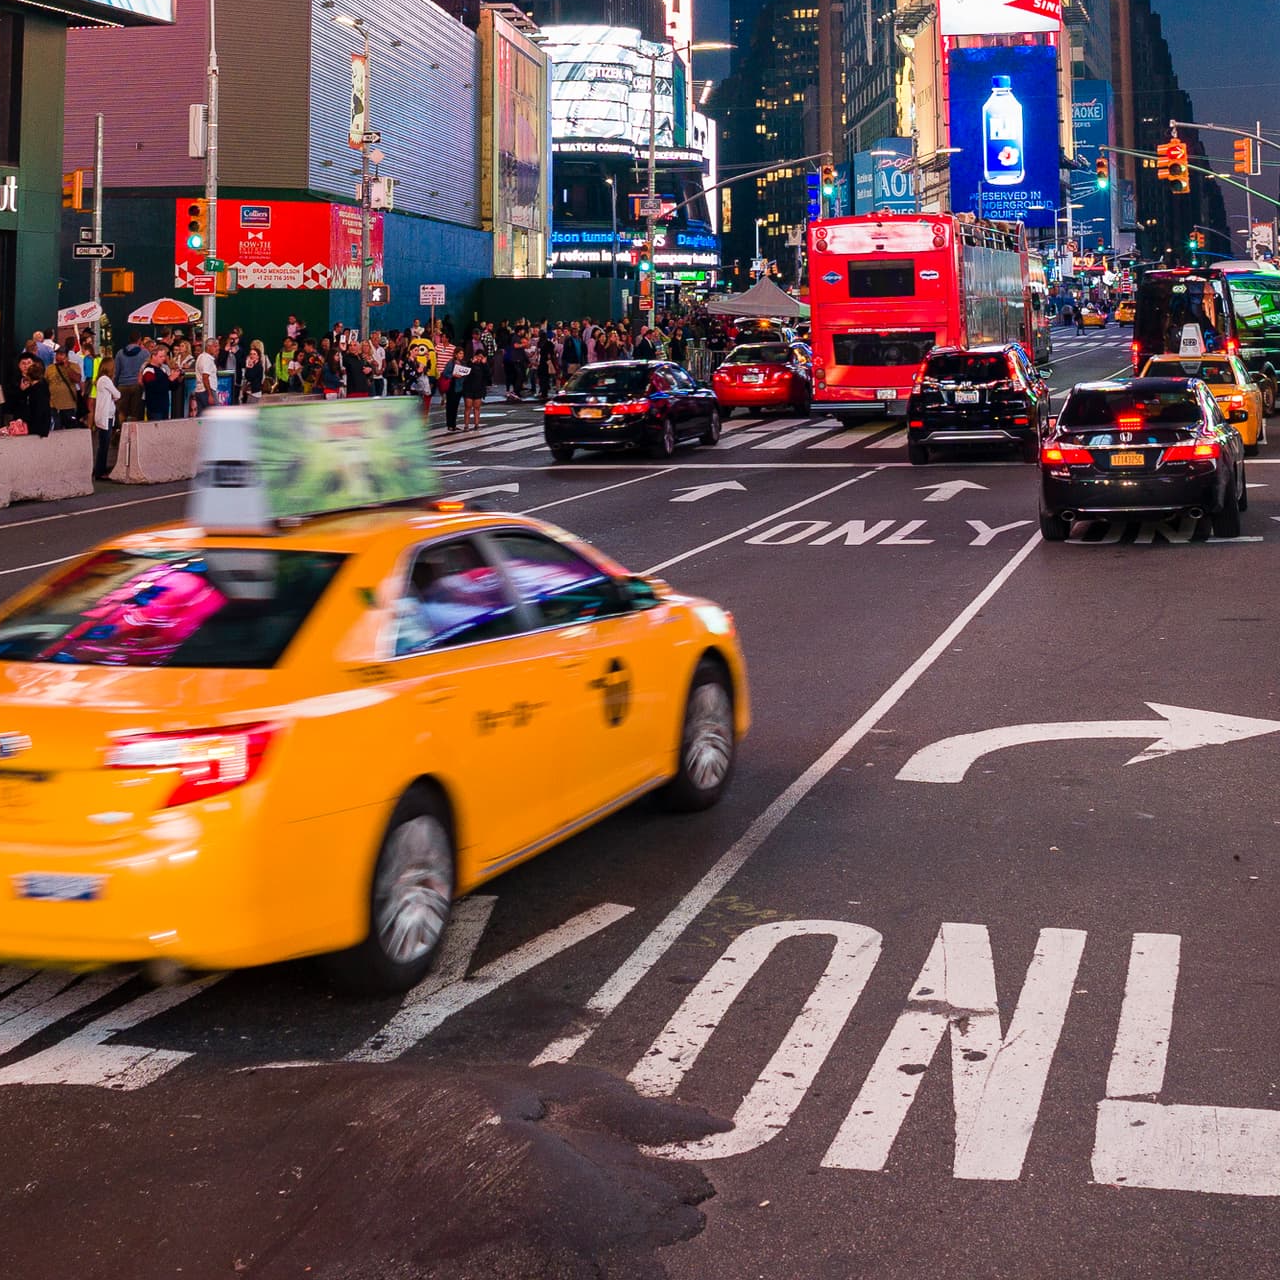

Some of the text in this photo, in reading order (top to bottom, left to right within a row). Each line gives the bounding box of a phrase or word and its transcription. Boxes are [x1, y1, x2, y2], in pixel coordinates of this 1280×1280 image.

[1030, 191, 1041, 200] IN
[243, 208, 269, 219] Colliers
[743, 520, 1035, 545] ONLY
